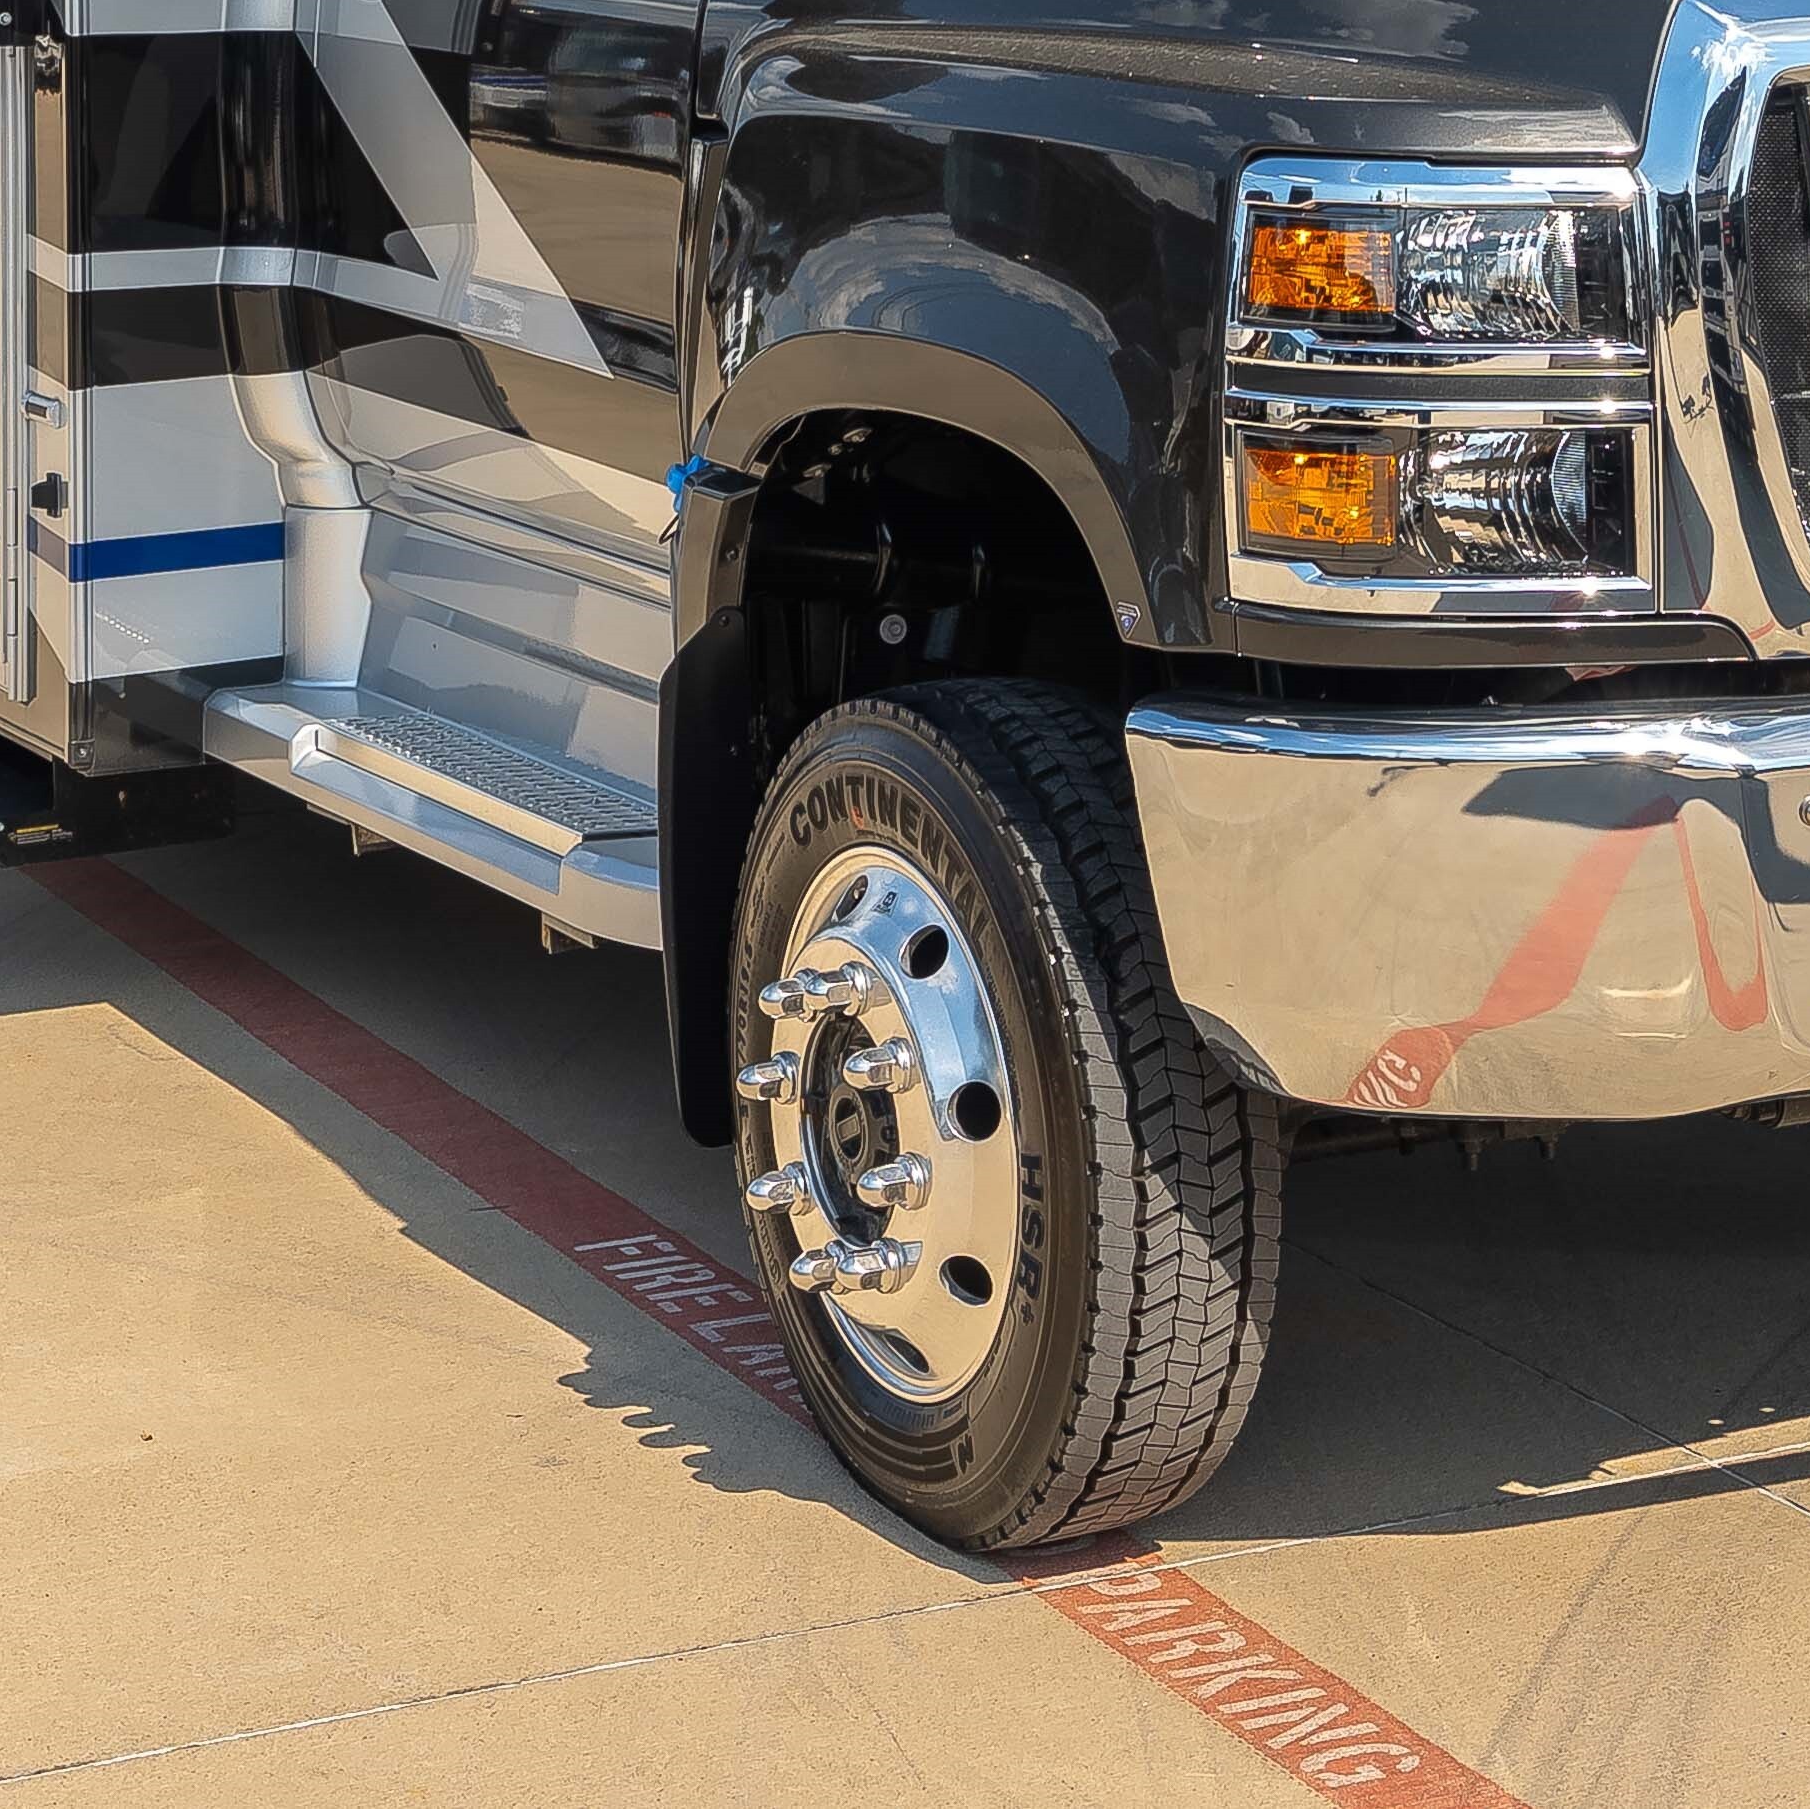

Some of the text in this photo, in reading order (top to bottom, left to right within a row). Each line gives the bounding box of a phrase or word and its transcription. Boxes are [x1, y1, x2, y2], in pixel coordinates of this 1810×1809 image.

[790, 773, 991, 961] CONTINENTAL
[574, 1234, 813, 1415] FIRE LA
[1038, 1561, 1421, 1788] PARKING
